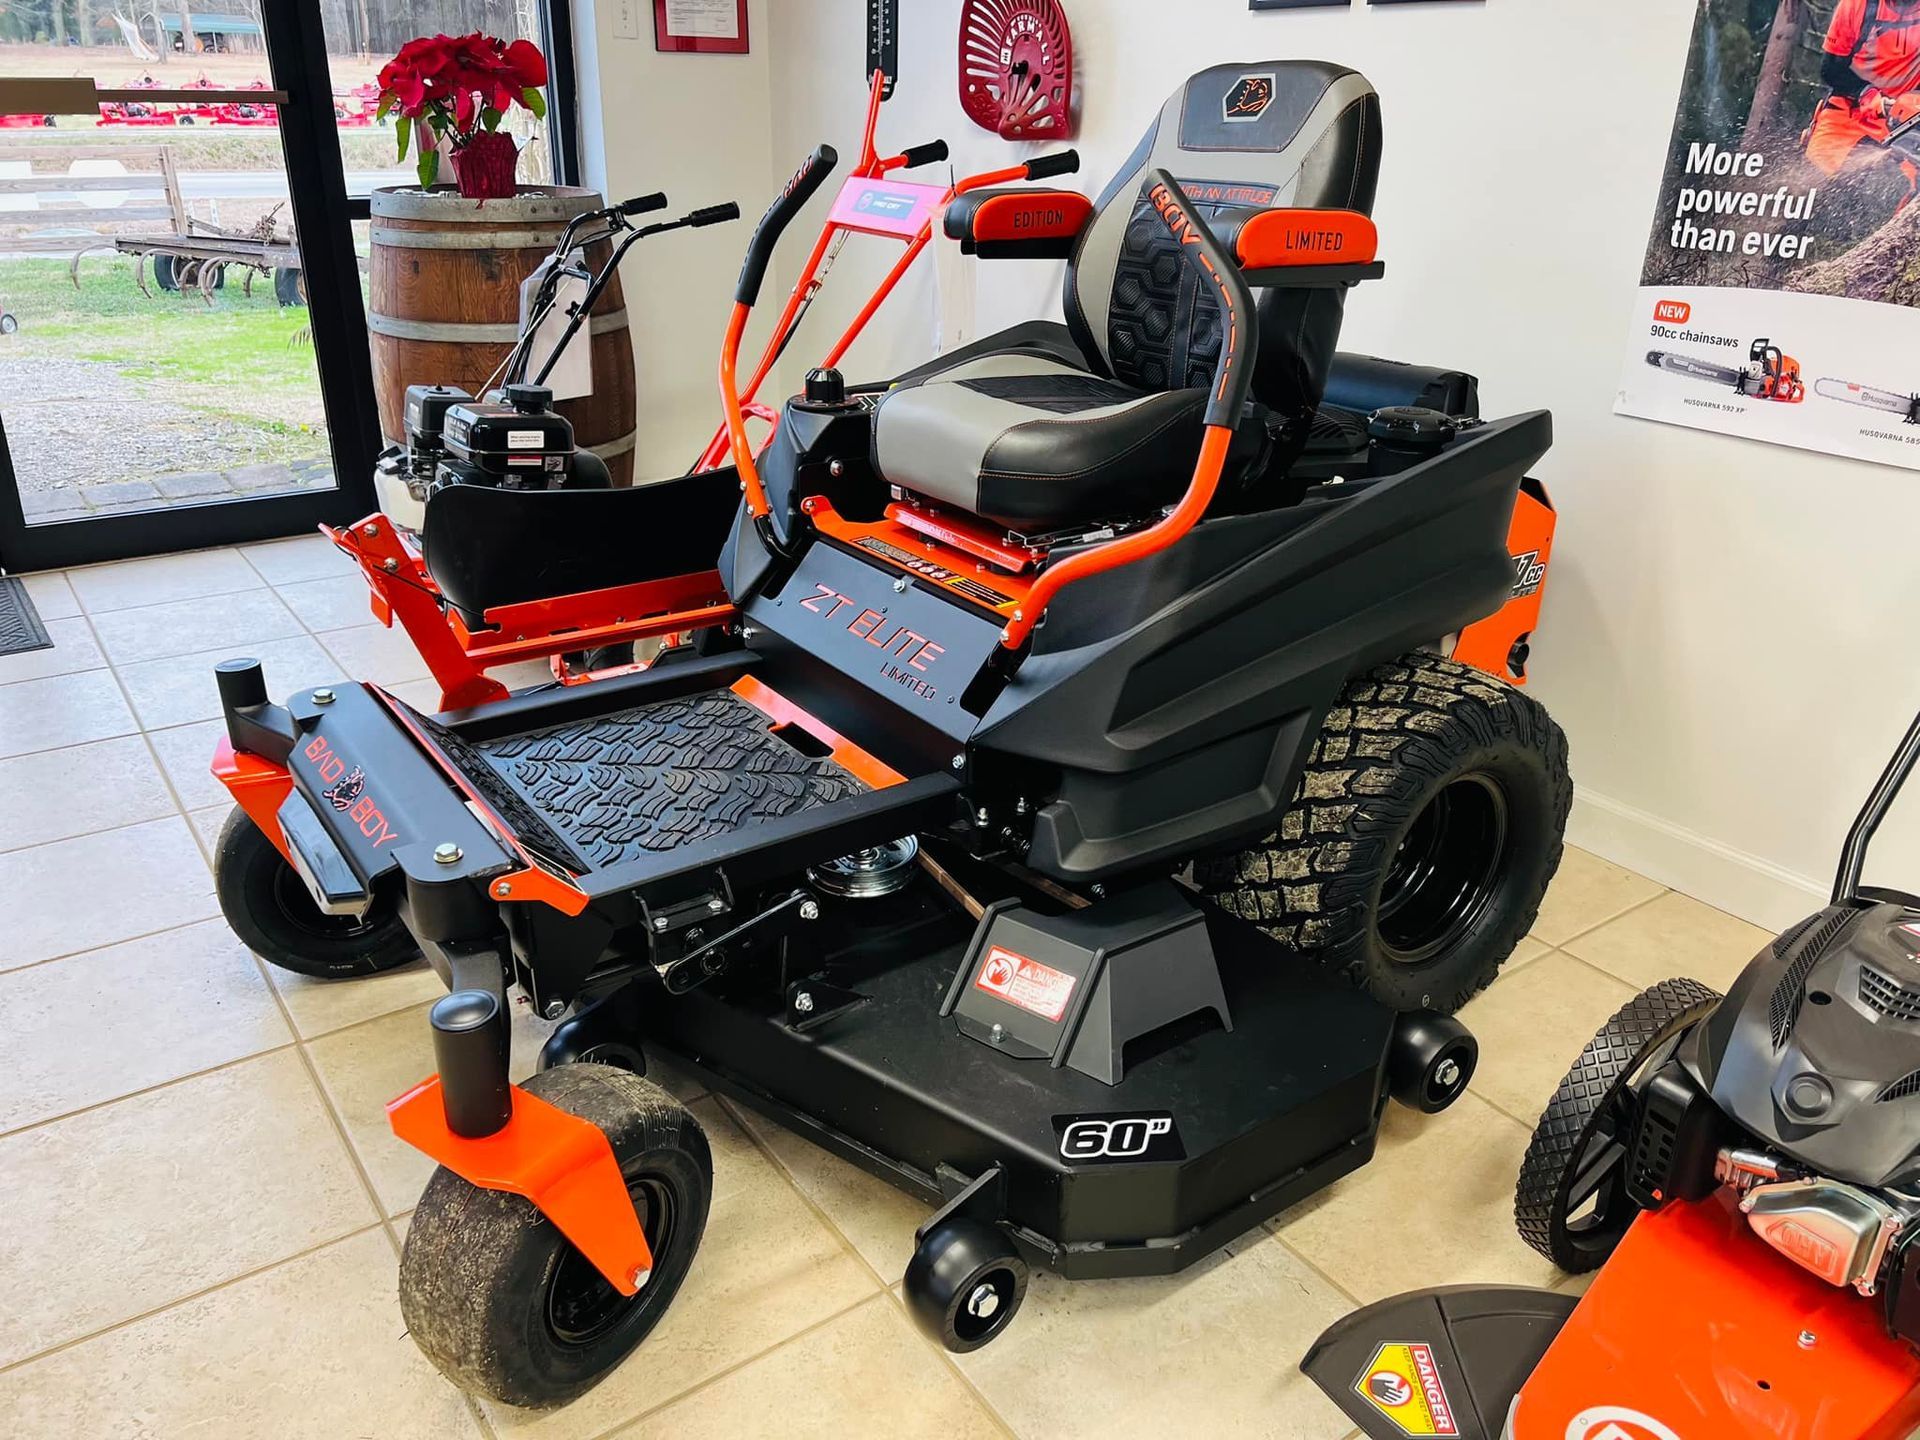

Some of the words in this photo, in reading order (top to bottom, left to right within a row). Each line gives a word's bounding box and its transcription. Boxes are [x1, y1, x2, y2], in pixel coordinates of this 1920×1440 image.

[1005, 20, 1050, 65] FARMALL
[1685, 142, 1764, 177] More
[1014, 209, 1064, 229] EDITION
[1675, 186, 1817, 220] powerful
[1285, 231, 1343, 251] LIMITED
[1670, 218, 1736, 253] than
[1742, 231, 1814, 259] ever
[1657, 304, 1687, 319] NEW
[1650, 325, 1677, 341] 90cc
[1679, 329, 1740, 348] chainsaws
[1683, 398, 1721, 410] HUSQVARNA
[1859, 428, 1903, 442] HUSQVARNA
[799, 582, 856, 620] ZT
[847, 608, 946, 672] ELITE
[880, 661, 937, 701] LIMITED
[304, 735, 346, 784] BAD
[349, 795, 399, 848] BOY
[1413, 1350, 1450, 1429] DANGER
